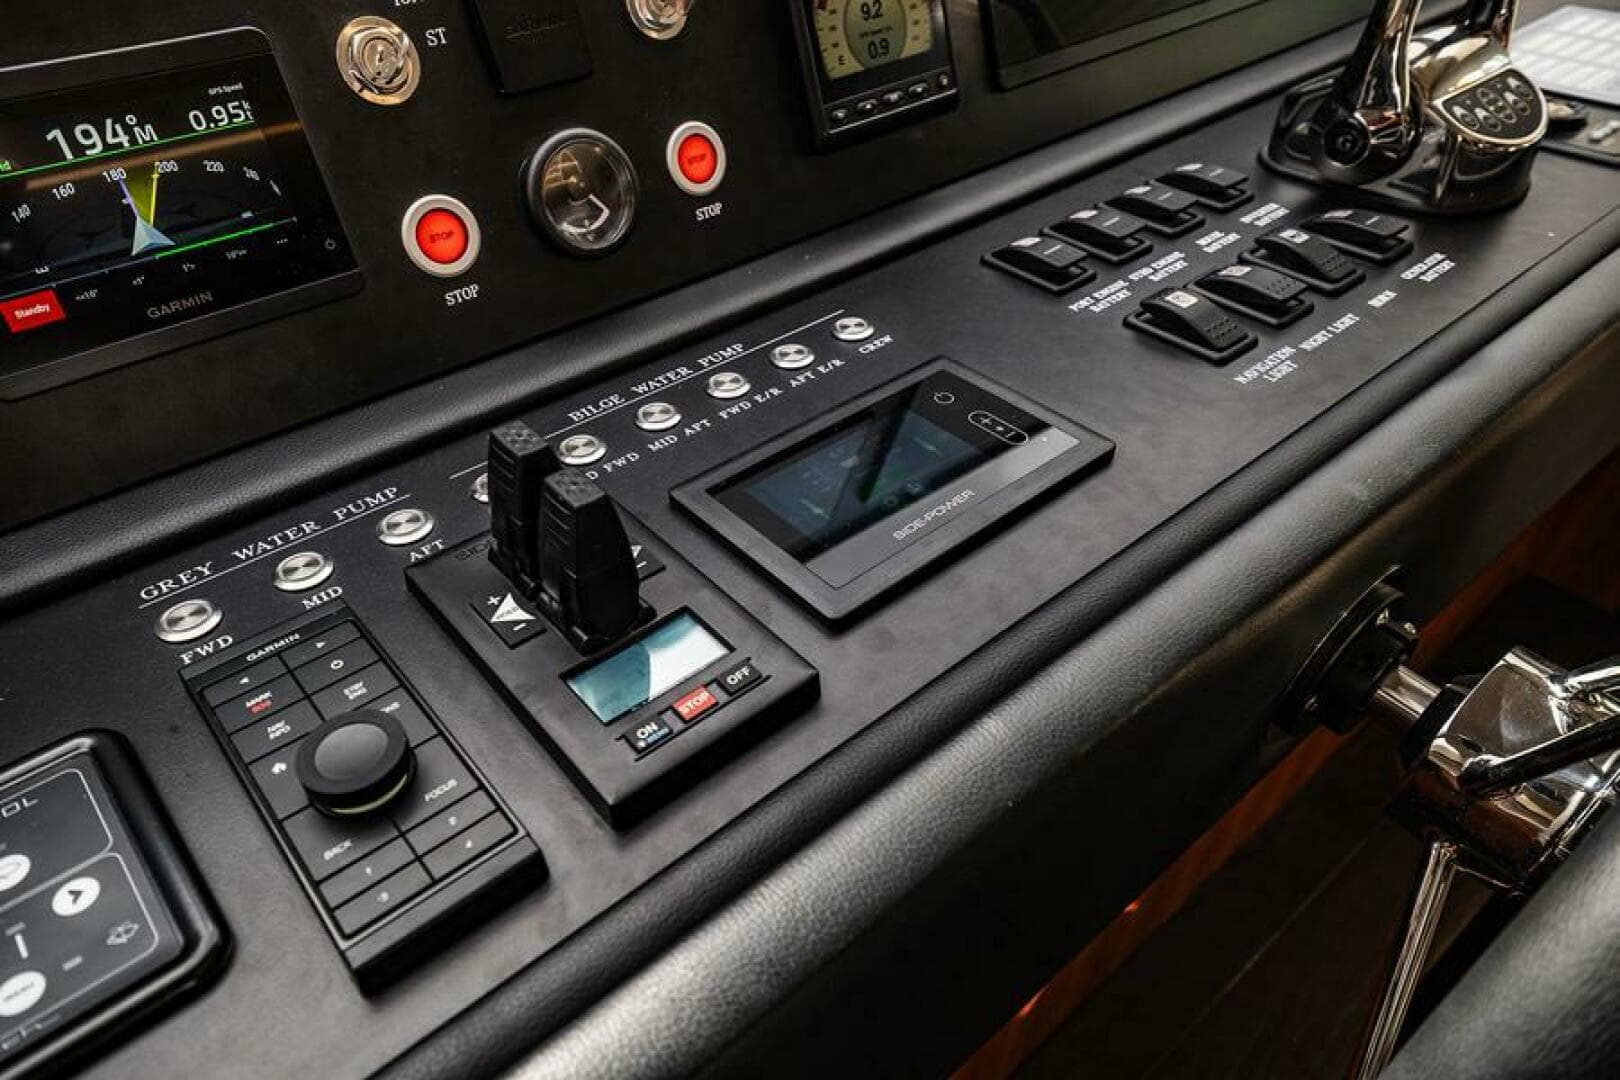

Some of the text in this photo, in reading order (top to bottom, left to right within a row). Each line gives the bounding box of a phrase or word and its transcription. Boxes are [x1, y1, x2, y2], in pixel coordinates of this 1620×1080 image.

[52, 182, 75, 200] 160
[695, 203, 722, 221] STOP
[146, 290, 214, 318] GARMIN
[444, 283, 479, 306] STOP
[567, 343, 744, 421] BILGE WATER PUMP
[647, 435, 678, 452] MID
[139, 486, 399, 601] GREY WATER PUMP
[409, 539, 446, 562] AFT
[301, 586, 343, 610] MID
[180, 634, 234, 665] FWD
[246, 632, 300, 661] GARMIN
[726, 665, 750, 685] OFF
[678, 691, 710, 714] STOP
[636, 721, 658, 738] ON
[424, 778, 458, 802] FOCUS
